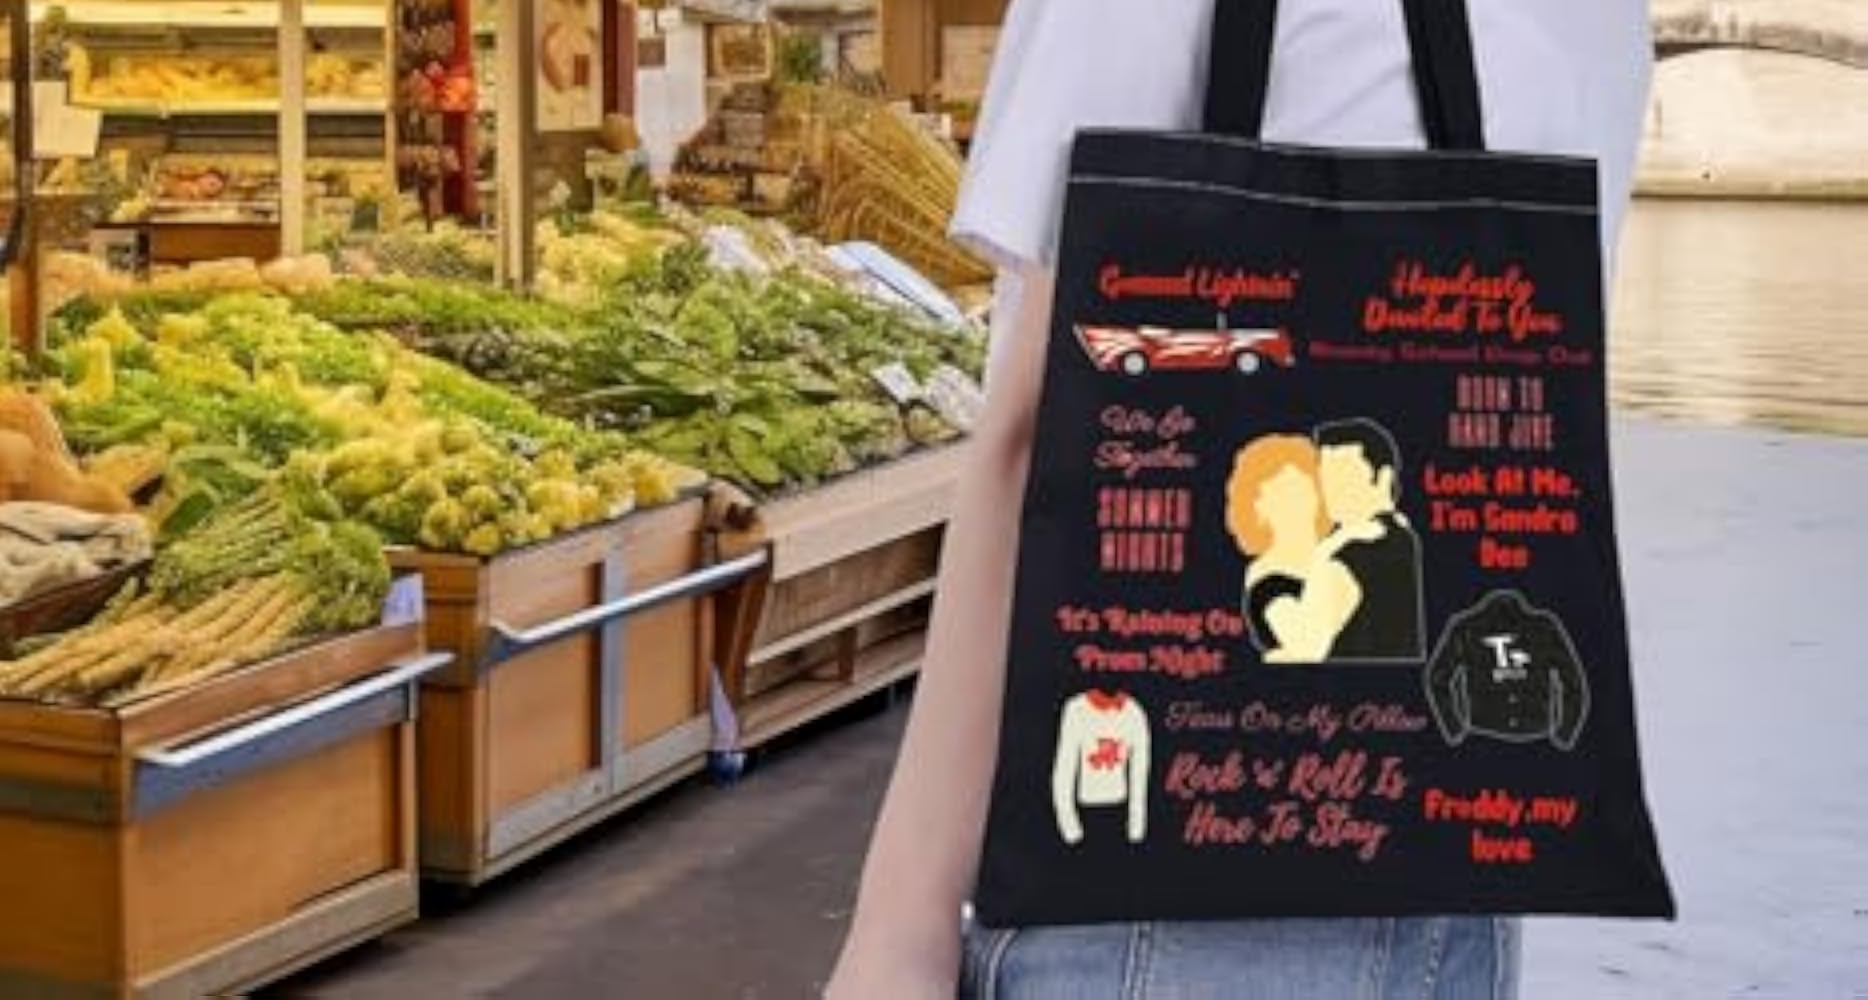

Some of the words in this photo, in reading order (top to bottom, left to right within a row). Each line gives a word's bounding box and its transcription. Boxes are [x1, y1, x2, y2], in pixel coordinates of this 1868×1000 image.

[1423, 466, 1488, 495] Look
[1431, 500, 1479, 531] I'm
[1287, 751, 1367, 800] Roll
[1471, 825, 1533, 862] love
